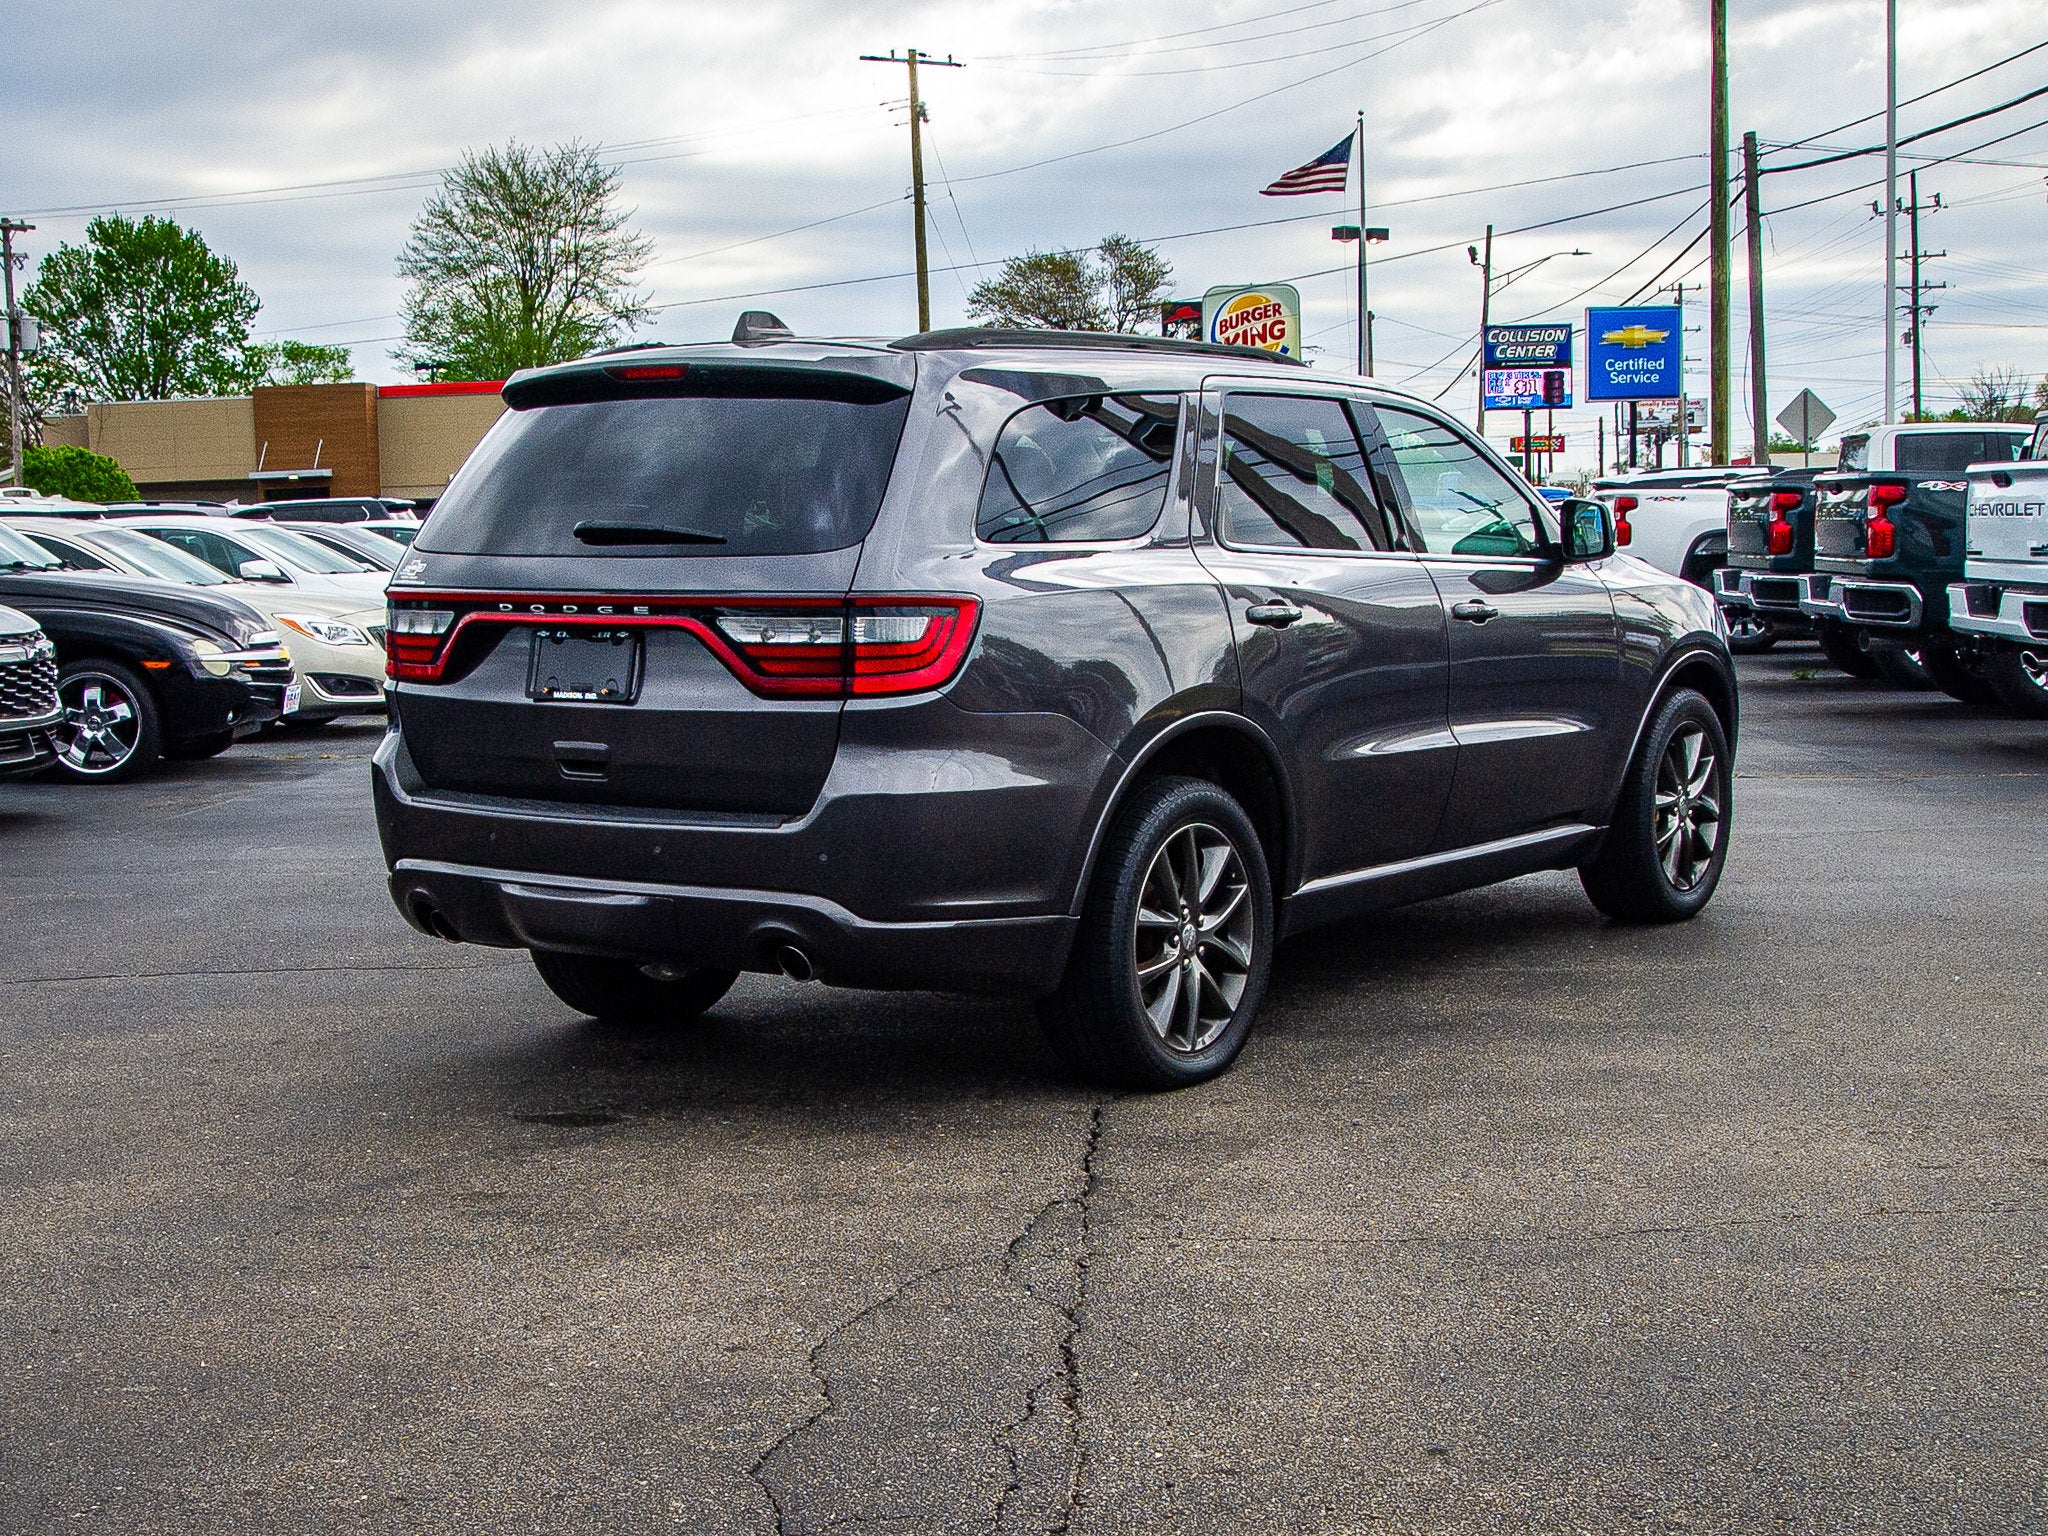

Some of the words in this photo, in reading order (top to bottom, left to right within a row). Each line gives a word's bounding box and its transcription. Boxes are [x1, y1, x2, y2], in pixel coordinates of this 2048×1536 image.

[1219, 302, 1283, 336] BURGER
[1488, 329, 1567, 343] COLLISION
[1495, 345, 1556, 358] CENTER
[1605, 358, 1665, 371] Certified
[1610, 371, 1660, 384] Service
[1969, 502, 2046, 517] CHEVROLET
[499, 603, 649, 615] DODGE
